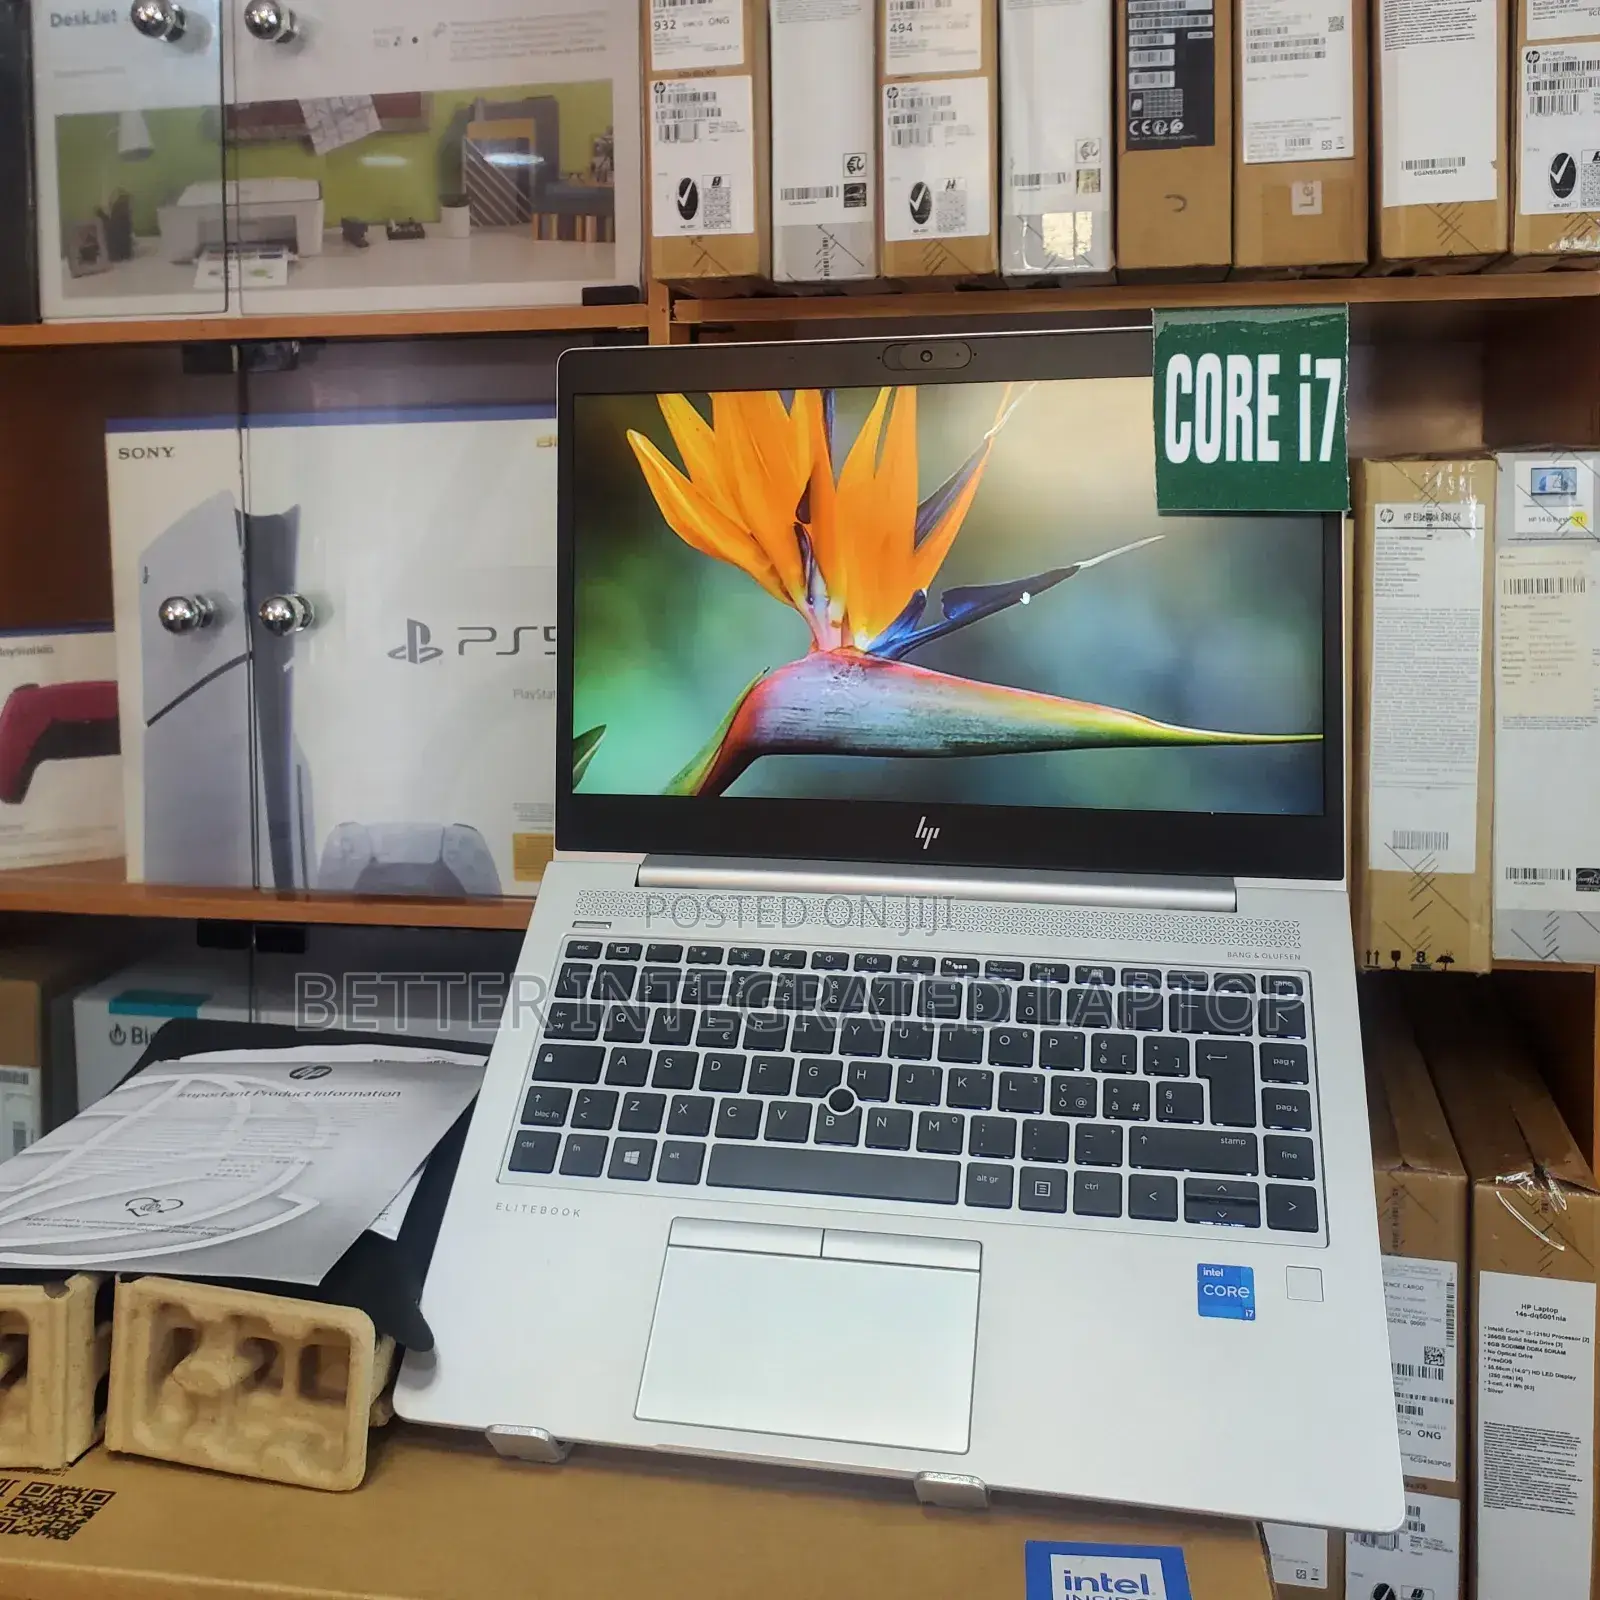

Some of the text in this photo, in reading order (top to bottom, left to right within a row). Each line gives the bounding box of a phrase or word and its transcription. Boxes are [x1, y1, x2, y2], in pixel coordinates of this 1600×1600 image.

[50, 9, 117, 28] DeskJet
[654, 19, 677, 32] 932
[890, 22, 913, 34] 494
[1165, 352, 1342, 464] CORE i7
[118, 446, 175, 460] SONY
[1403, 512, 1412, 521] HP
[1227, 951, 1251, 959] BANG
[1261, 952, 1301, 961] OLUFSEN
[784, 978, 794, 988] %
[830, 980, 839, 989] &
[644, 984, 653, 995] 2
[689, 987, 698, 997] 3
[783, 991, 791, 1001] 5
[829, 994, 838, 1004] 6
[878, 997, 886, 1007] 7
[926, 1000, 935, 1010] 8
[975, 1003, 984, 1013] 9
[615, 1012, 627, 1023] Q
[662, 1014, 677, 1025] W
[707, 1017, 716, 1028] E
[753, 1020, 764, 1031] R
[801, 1022, 810, 1033] T
[850, 1025, 861, 1036] Y
[721, 1031, 731, 1041] €
[899, 1028, 909, 1039] U
[948, 1031, 953, 1042] I
[999, 1035, 1011, 1046] O
[1049, 1038, 1059, 1049] P
[616, 1055, 628, 1066] A
[663, 1058, 674, 1069] S
[710, 1060, 722, 1071] D
[1273, 1057, 1290, 1067] pag
[758, 1063, 768, 1074] F
[808, 1066, 819, 1077] G
[856, 1069, 867, 1080] H
[905, 1073, 915, 1084] J
[1032, 1076, 1039, 1084] 3
[957, 1077, 968, 1088] K
[1008, 1080, 1018, 1092] L
[1059, 1083, 1068, 1093] ç
[178, 1089, 401, 1099] Important Product Information
[1165, 1090, 1173, 1100] §
[629, 1100, 640, 1112] Z
[1075, 1097, 1088, 1109] @
[1131, 1102, 1141, 1112] #
[1275, 1102, 1292, 1112] pag
[677, 1103, 689, 1115] X
[727, 1106, 738, 1117] C
[776, 1109, 788, 1120] V
[534, 1110, 560, 1120] bloc fn
[825, 1115, 835, 1127] B
[876, 1116, 887, 1128] N
[928, 1120, 940, 1132] M
[521, 1140, 535, 1149] ctrl
[1220, 1137, 1247, 1146] stamp
[572, 1144, 581, 1152] fn
[669, 1151, 680, 1159] alt
[1280, 1150, 1298, 1160] fine
[976, 1174, 999, 1184] alt gr
[1084, 1182, 1099, 1191] ctrl
[495, 1201, 582, 1218] ELITEBOOK
[1203, 1267, 1224, 1277] intel
[1245, 1309, 1254, 1317] i7
[1533, 1305, 1559, 1314] Laptop
[1552, 1334, 1581, 1342] Processor
[1555, 1372, 1577, 1381] Display
[1417, 1429, 1442, 1440] ONG
[1063, 1569, 1150, 1595] intel
